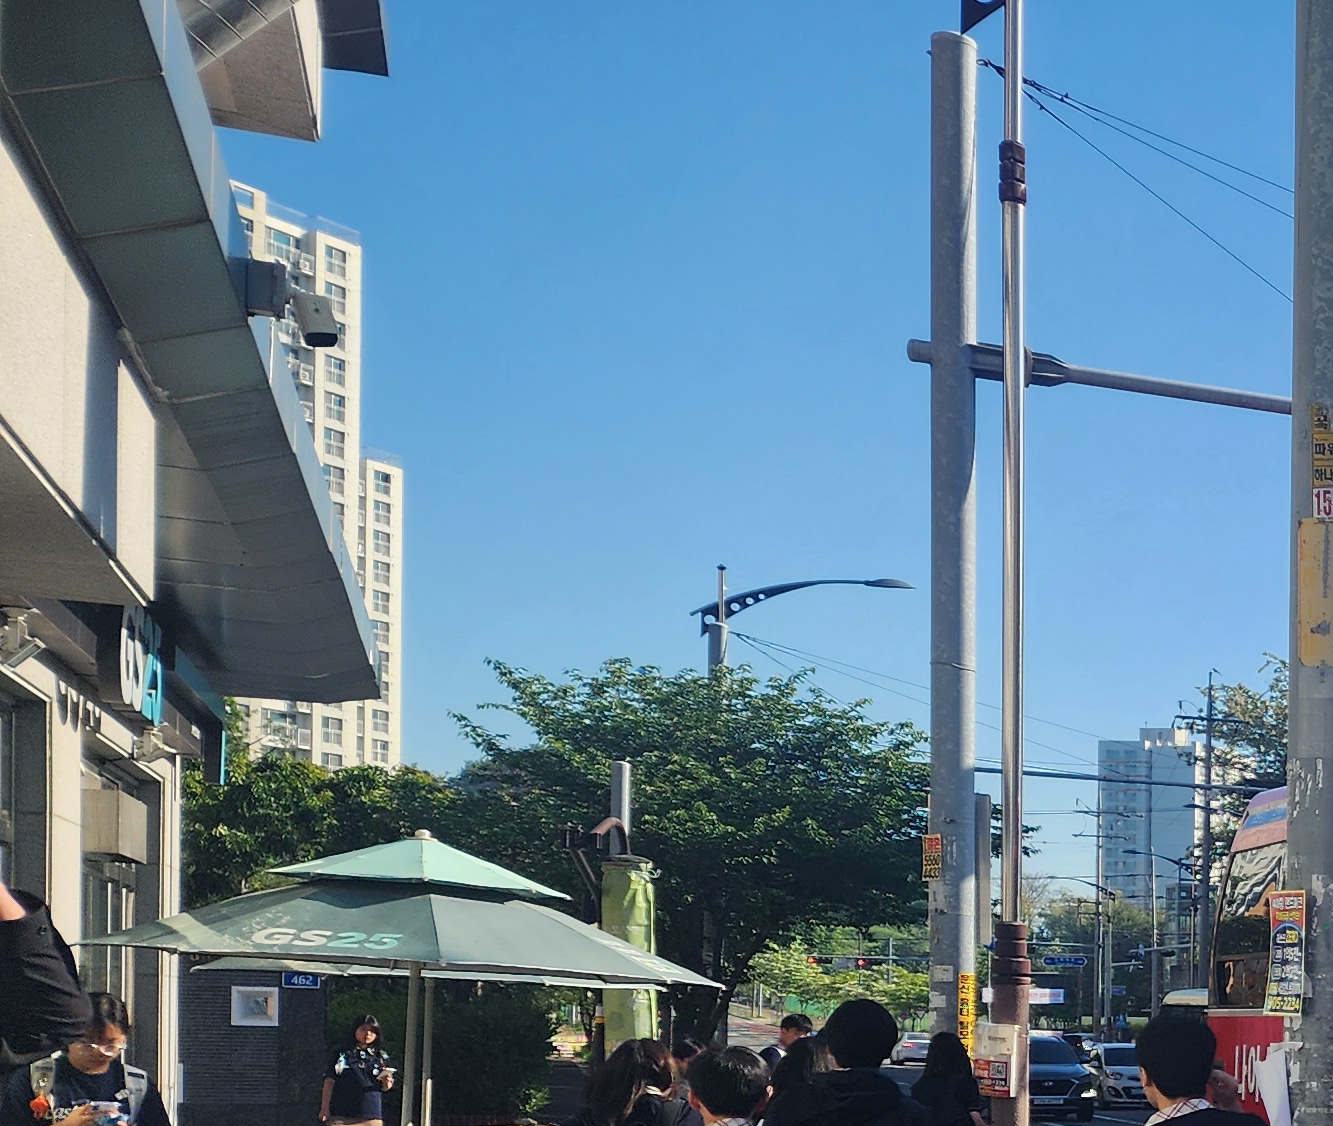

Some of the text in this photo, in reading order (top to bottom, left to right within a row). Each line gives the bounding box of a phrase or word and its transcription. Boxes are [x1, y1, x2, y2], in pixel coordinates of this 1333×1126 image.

[120, 604, 162, 727] GS25
[251, 927, 403, 950] GS25
[290, 974, 313, 986] 462
